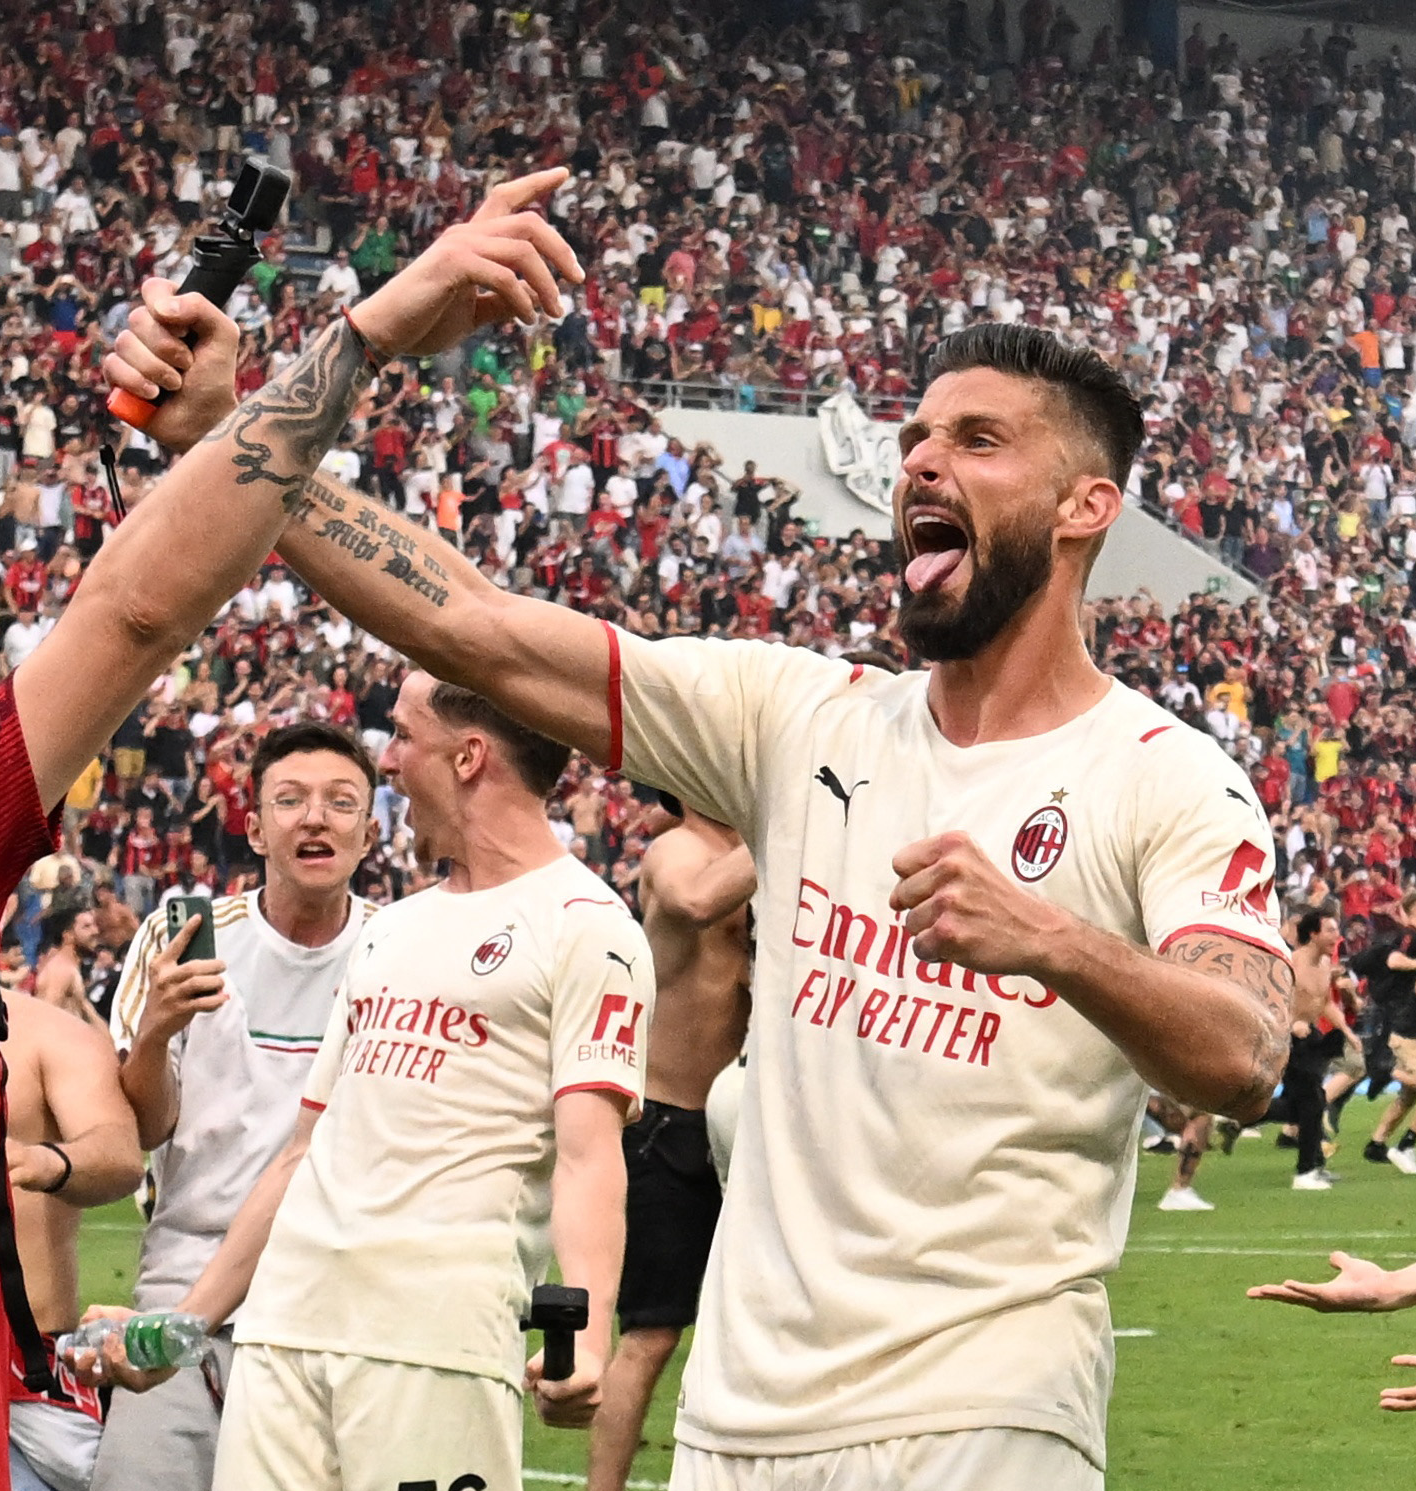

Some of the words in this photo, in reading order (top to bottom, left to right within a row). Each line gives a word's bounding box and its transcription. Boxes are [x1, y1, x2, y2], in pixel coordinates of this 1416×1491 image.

[1034, 812, 1061, 828] ACM
[347, 986, 490, 1048] mirates
[791, 969, 856, 1029] FLY
[857, 988, 1001, 1067] BETTER
[354, 1039, 446, 1084] BETTER
[578, 1043, 639, 1069] BitME
